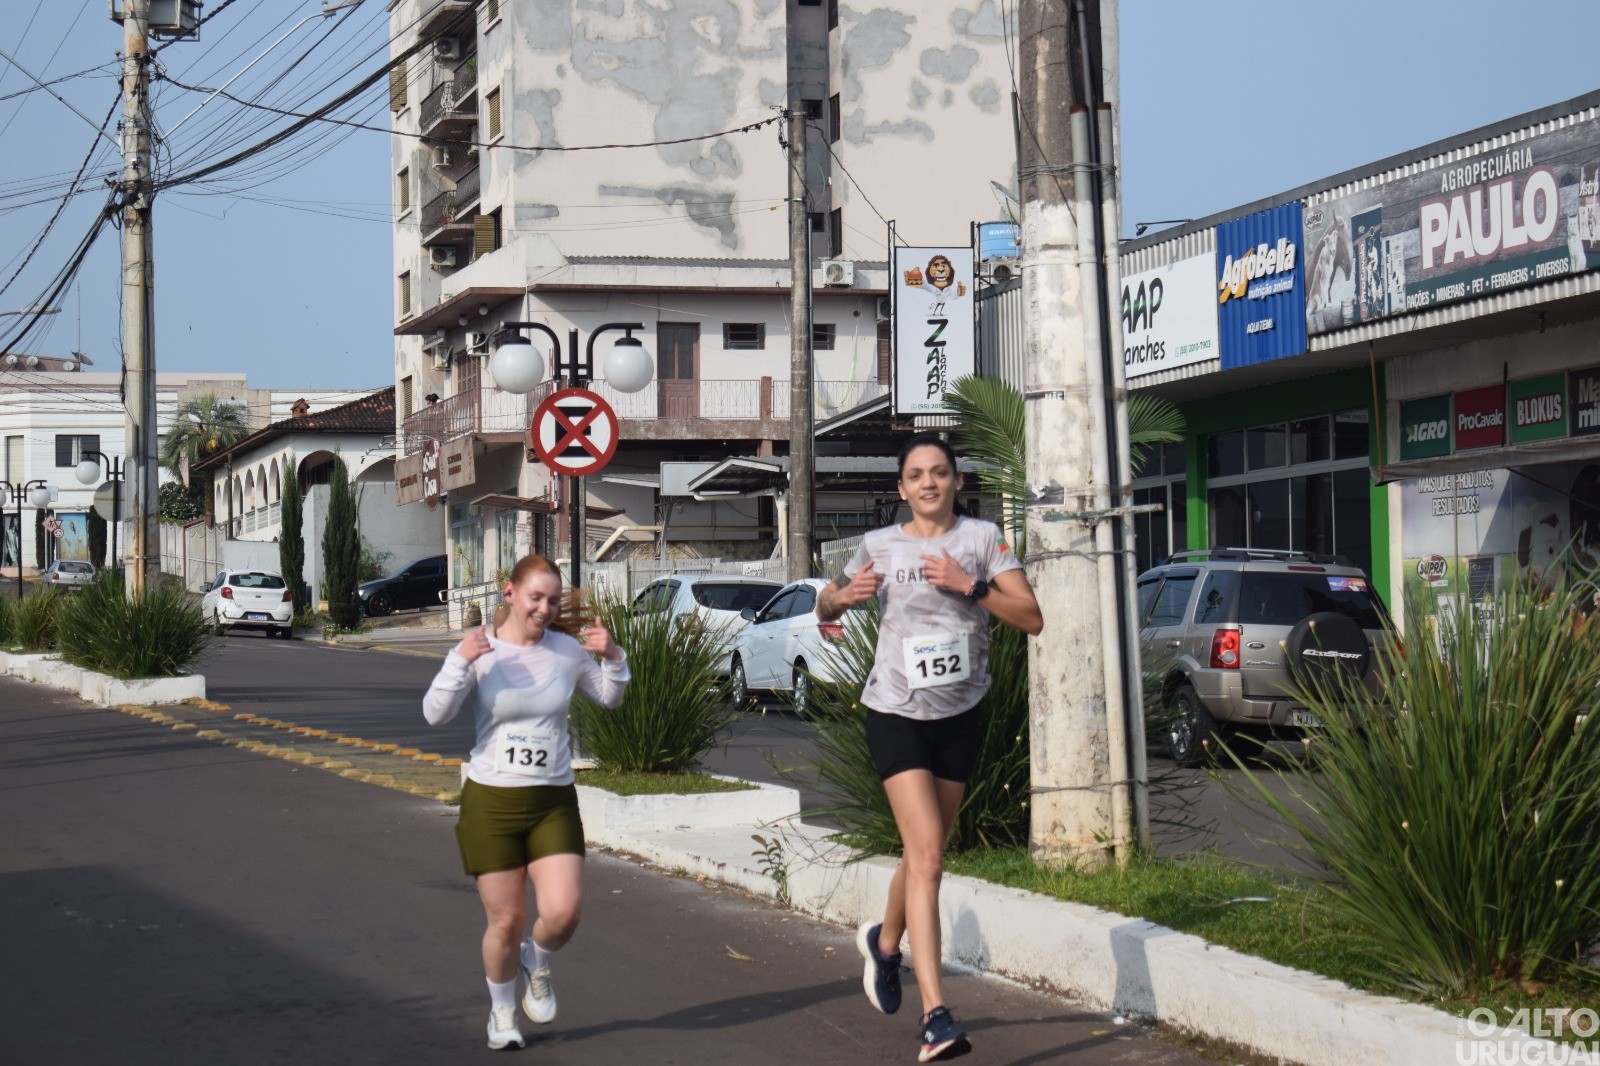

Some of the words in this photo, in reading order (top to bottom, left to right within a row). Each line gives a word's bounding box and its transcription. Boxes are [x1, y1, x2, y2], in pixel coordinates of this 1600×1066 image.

[1440, 147, 1533, 192] AGROPECUÁRIA
[1420, 169, 1559, 271] PAULO
[1220, 237, 1295, 295] AgroBella
[1248, 282, 1272, 300] nutrição
[1273, 275, 1294, 293] animal
[1406, 290, 1430, 310] RAÇÕES
[1436, 282, 1465, 302] MINERAIS
[1472, 277, 1484, 293] PET
[1491, 268, 1529, 290] FERRAGENS
[1536, 257, 1569, 279] DIVERSOS
[1122, 277, 1163, 334] AAP
[1246, 320, 1260, 334] AQUI
[1124, 335, 1165, 366] anches
[1516, 393, 1562, 426] BLOKUS
[1407, 419, 1447, 443] AGRO
[1417, 477, 1436, 494] MAIS
[1419, 561, 1445, 576] SUPRA
[915, 654, 962, 679] 152
[504, 746, 548, 767] 132
